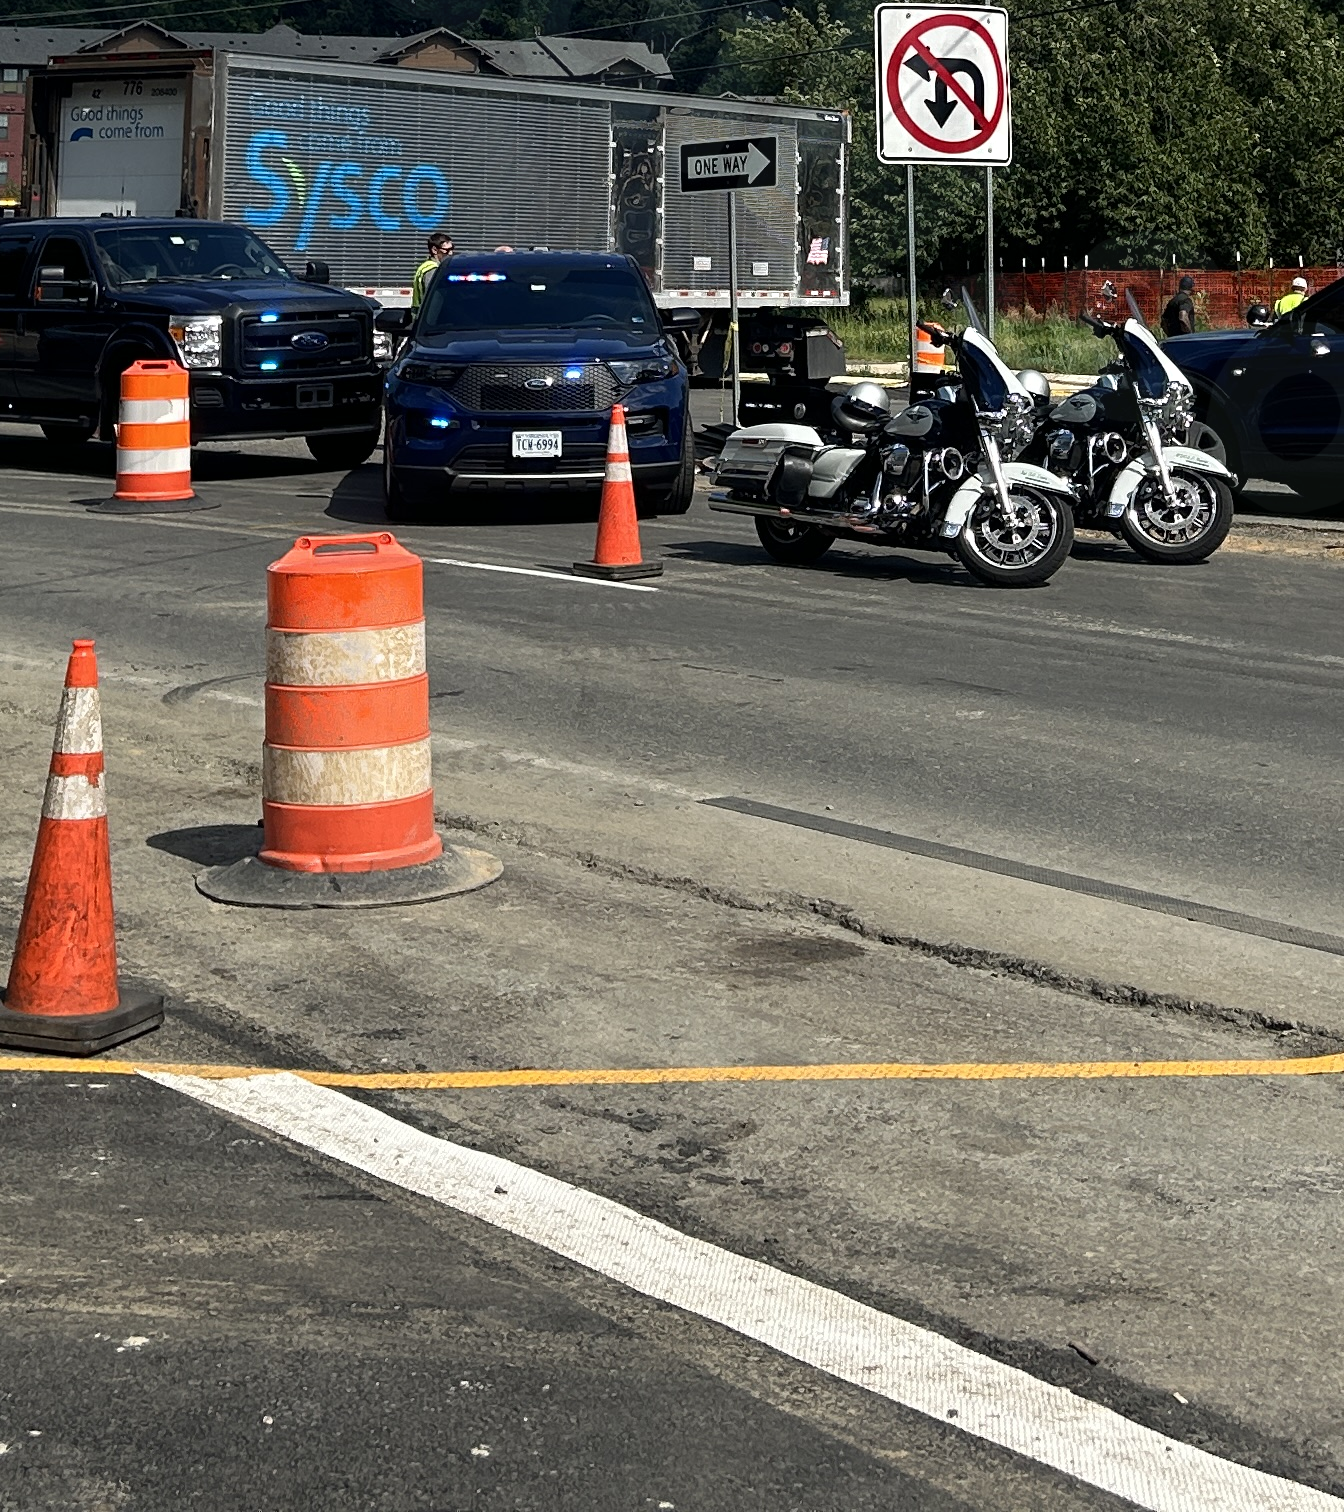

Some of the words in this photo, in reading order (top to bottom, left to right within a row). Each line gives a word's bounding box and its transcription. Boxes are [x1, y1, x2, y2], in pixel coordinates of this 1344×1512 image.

[123, 80, 143, 96] 776
[70, 105, 103, 122] Good
[106, 105, 144, 125] things
[98, 126, 133, 139] come
[135, 122, 164, 139] from
[694, 157, 719, 176] ONE
[722, 154, 748, 174] WAY
[242, 129, 451, 252] Sysco
[516, 438, 559, 451] TCW-6994
